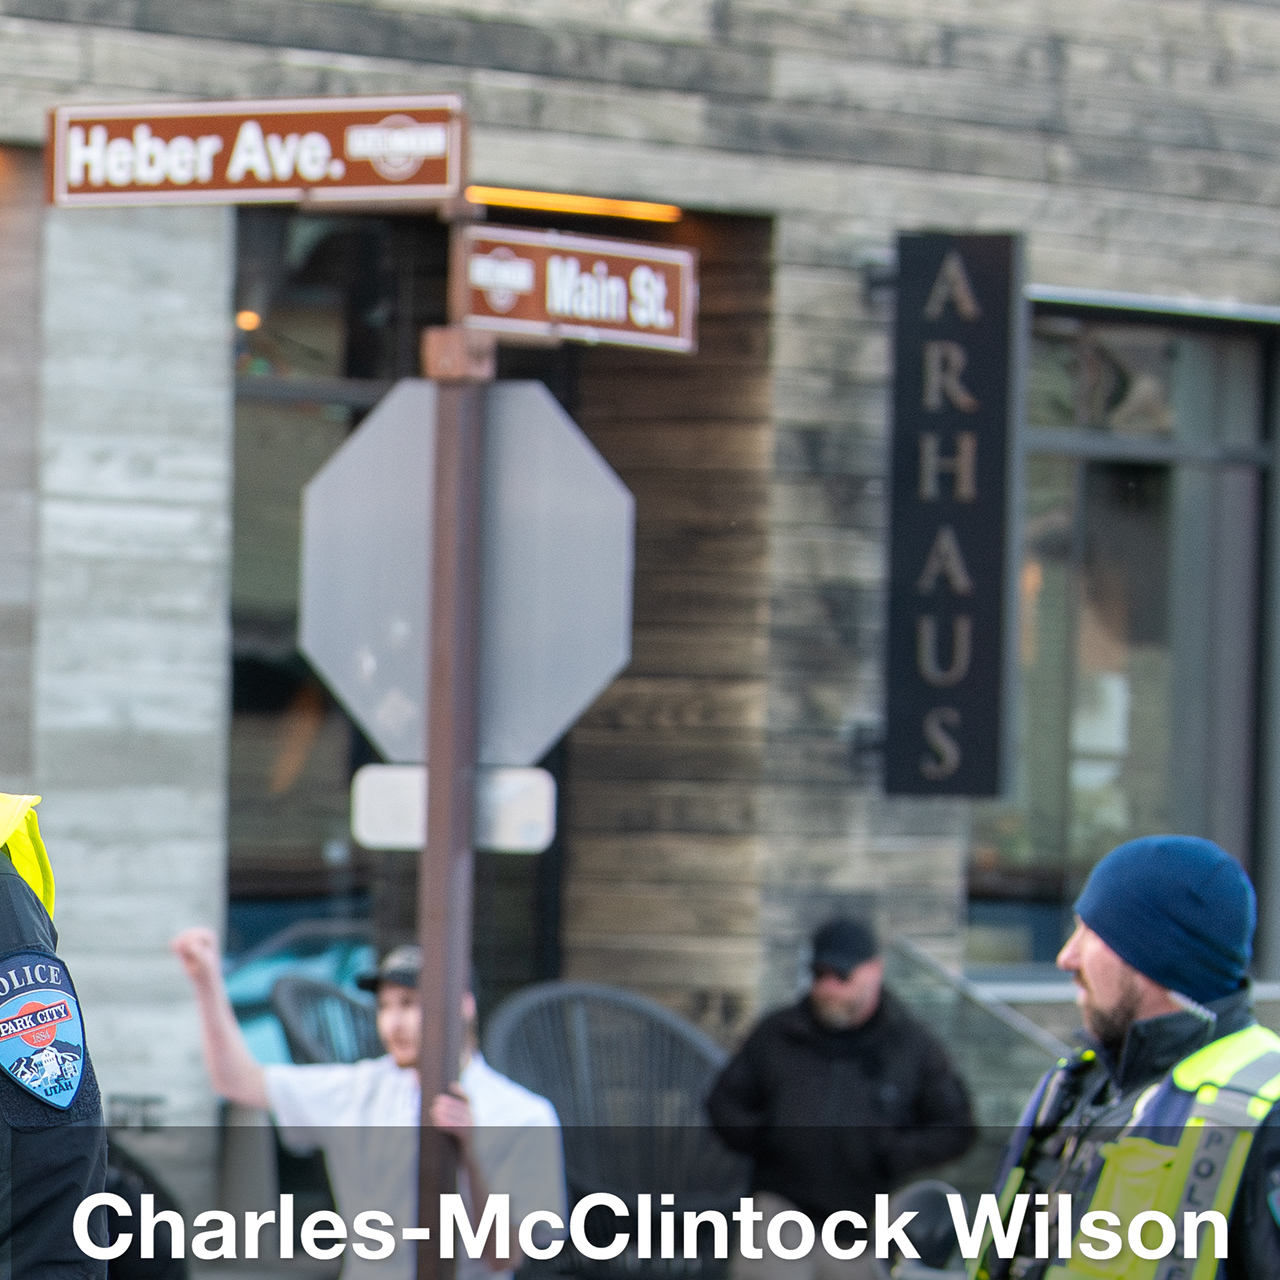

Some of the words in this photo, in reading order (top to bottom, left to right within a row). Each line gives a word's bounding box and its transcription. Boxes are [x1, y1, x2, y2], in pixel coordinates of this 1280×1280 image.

[68, 123, 224, 187] Heber
[225, 119, 346, 184] Ave.
[546, 255, 627, 324] Main
[630, 264, 675, 329] St.
[916, 250, 979, 781] ARHAUS
[36, 1004, 67, 1023] CITY
[31, 1030, 51, 1044] 1884
[44, 1081, 74, 1097] UTAH
